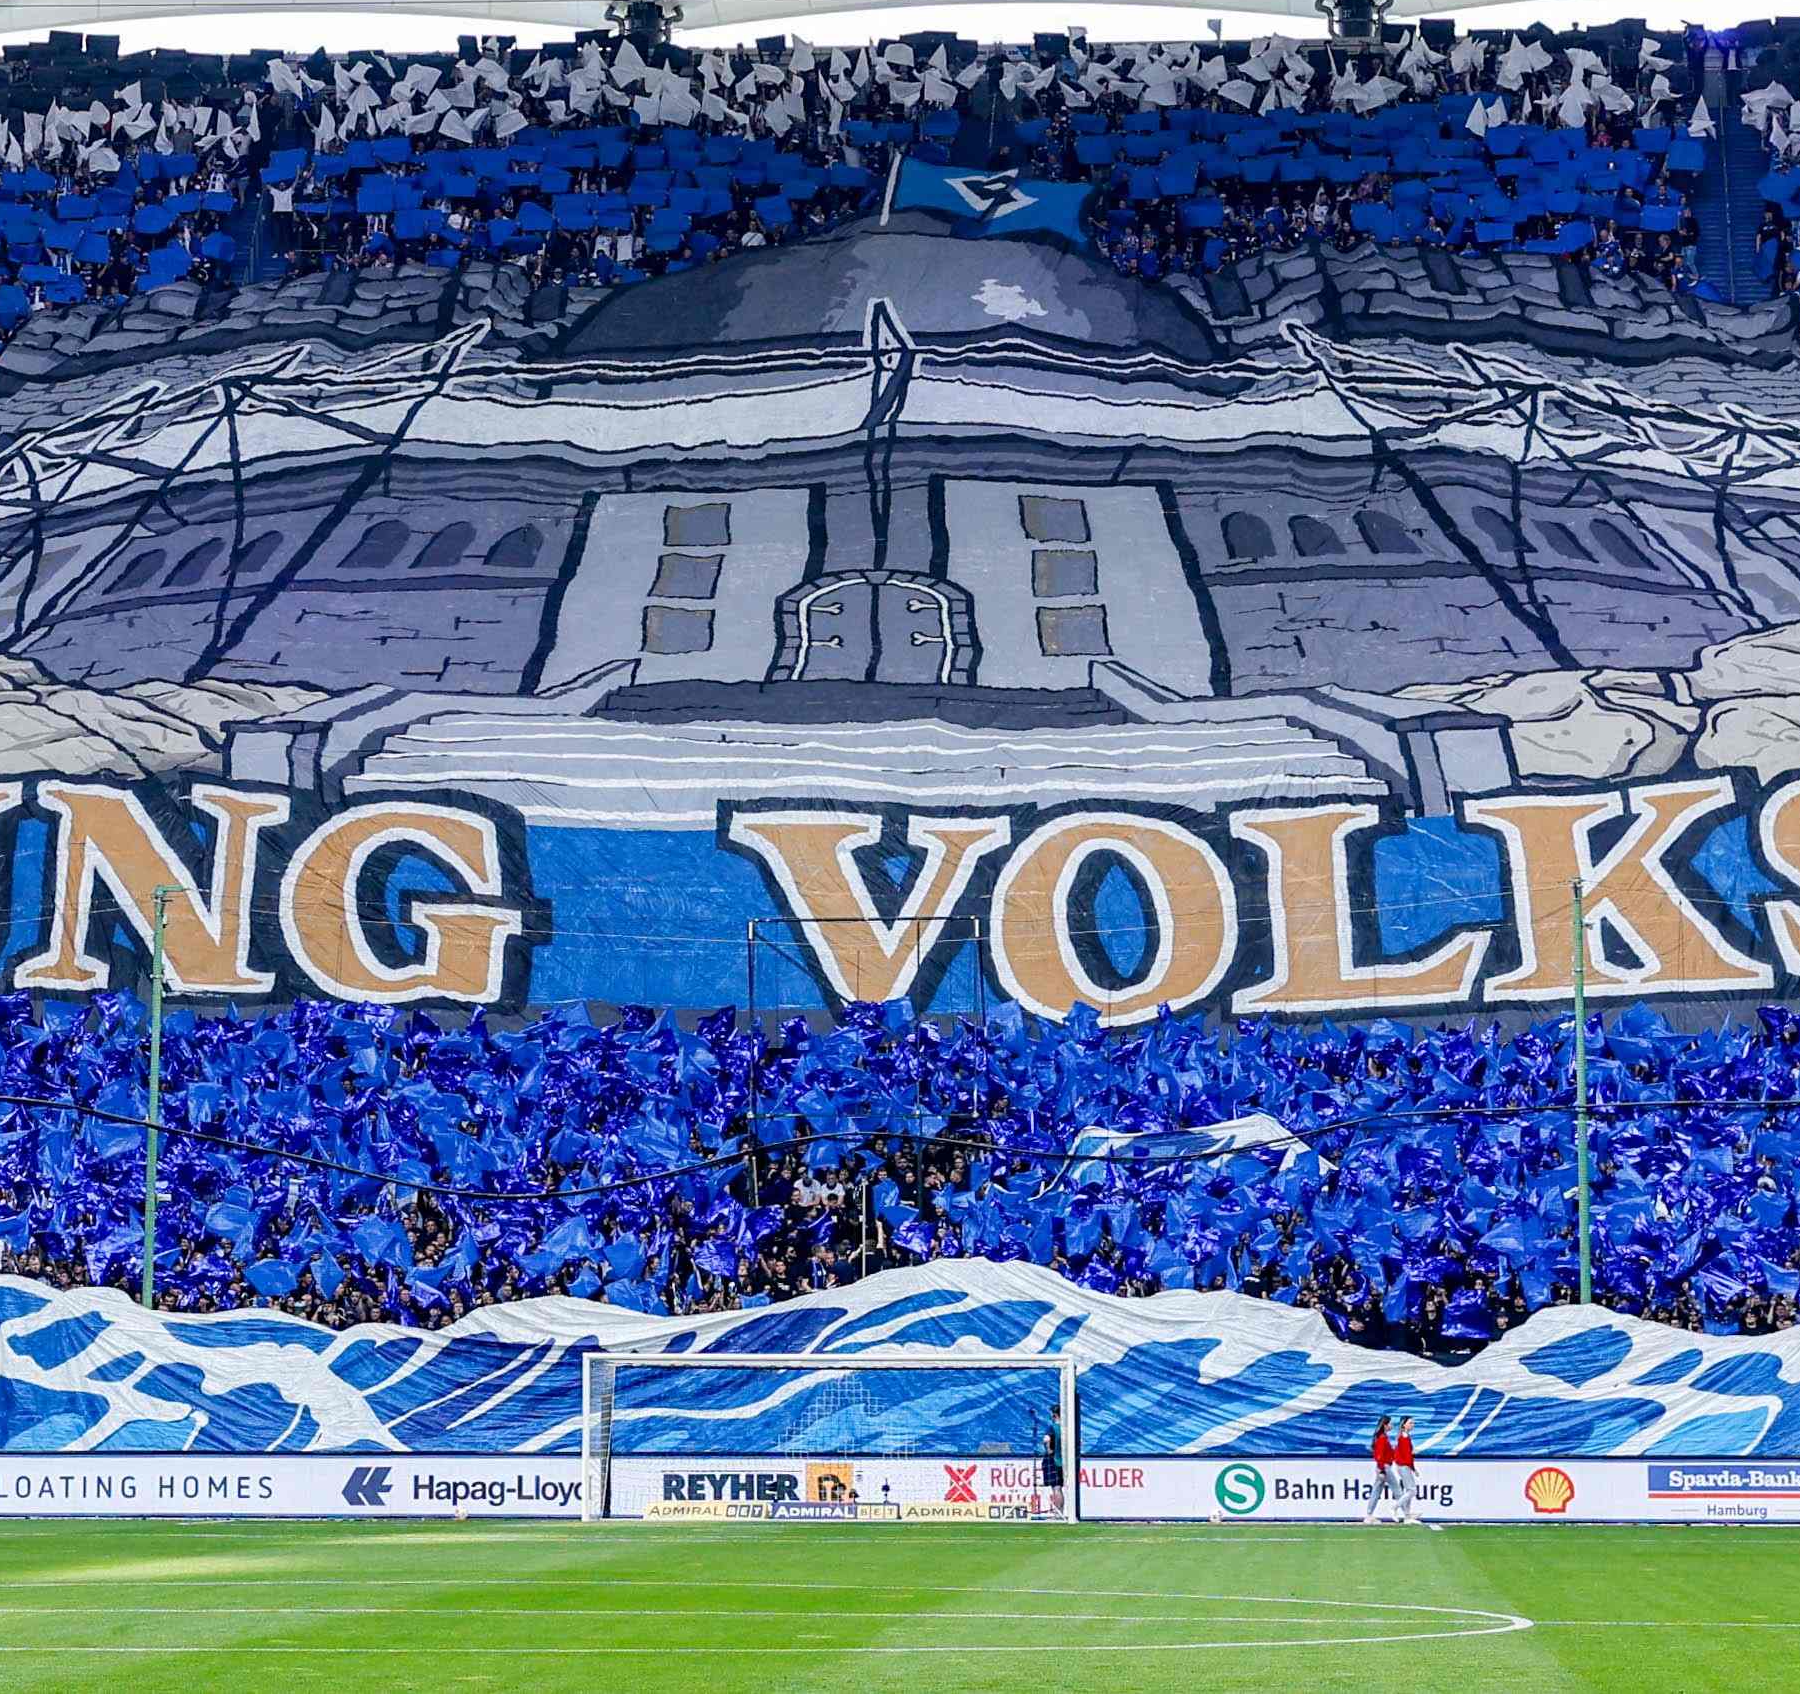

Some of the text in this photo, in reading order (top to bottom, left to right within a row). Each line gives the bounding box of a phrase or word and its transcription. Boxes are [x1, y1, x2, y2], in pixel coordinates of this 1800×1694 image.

[990, 1463, 1144, 1489] RÜGEALDER
[159, 1474, 274, 1500] HOMES
[662, 1473, 800, 1501] REYHER
[1275, 1477, 1334, 1501] Bahn
[649, 1506, 722, 1517] ADMIRAL
[774, 1506, 856, 1518] ADMIRAL
[906, 1506, 985, 1517] ADMIRAL
[1706, 1503, 1768, 1520] Hamburg
